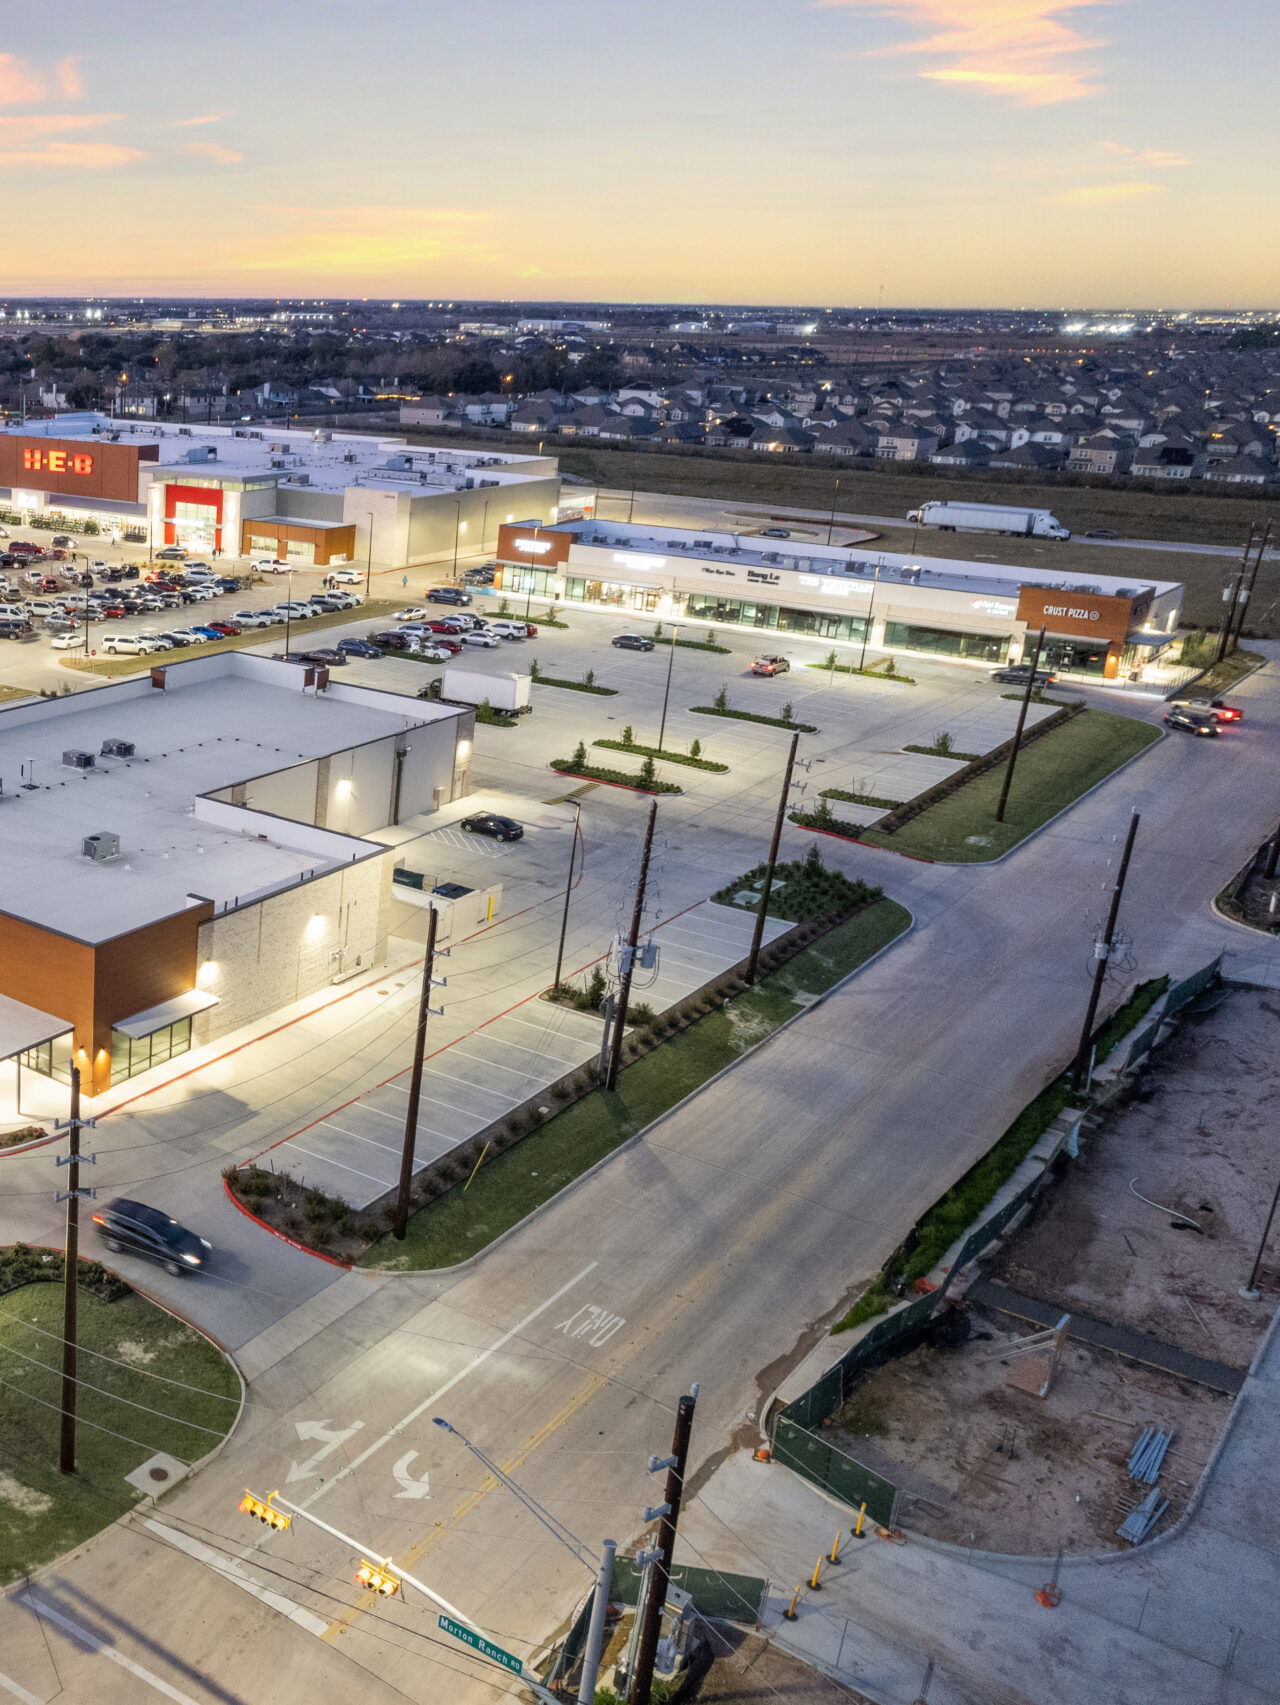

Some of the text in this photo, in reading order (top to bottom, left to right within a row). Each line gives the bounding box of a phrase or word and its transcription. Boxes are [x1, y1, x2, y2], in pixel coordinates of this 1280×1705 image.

[1043, 605, 1067, 616] CRUST
[1068, 608, 1089, 619] PIZZA
[554, 1303, 626, 1347] ONLY
[440, 1617, 520, 1670] Morton Ranch RD
